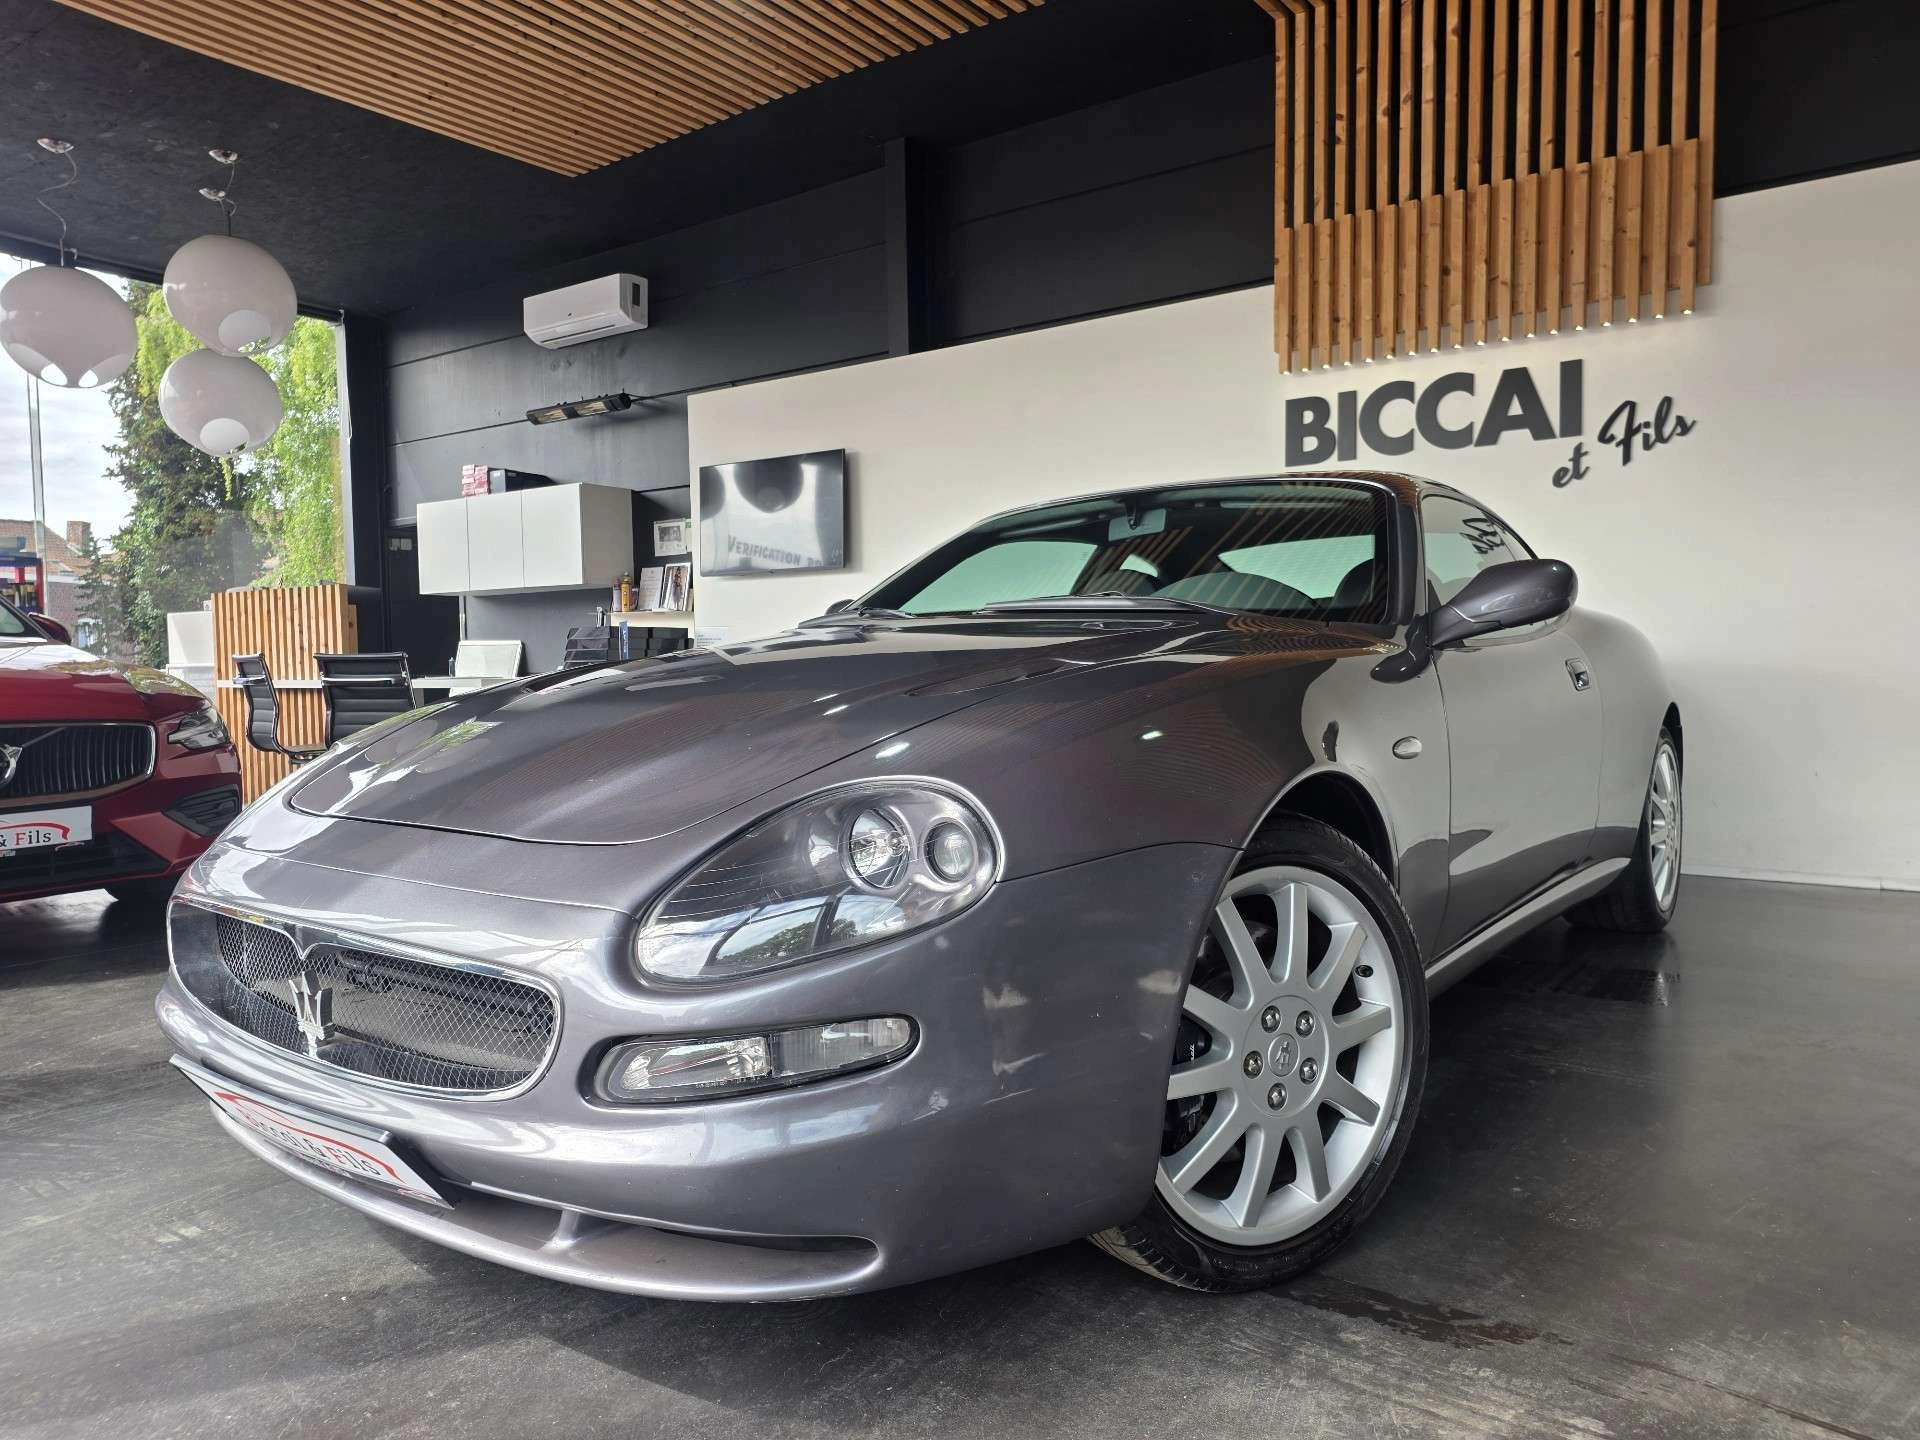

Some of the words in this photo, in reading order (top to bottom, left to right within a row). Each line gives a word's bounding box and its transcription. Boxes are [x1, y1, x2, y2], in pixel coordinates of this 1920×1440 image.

[1285, 359, 1583, 467] BICCAI
[1552, 443, 1589, 488] et
[1597, 396, 1696, 466] Fils
[728, 534, 801, 566] VERIFICATION
[15, 830, 52, 845] Fils
[322, 1145, 382, 1175] Fils
